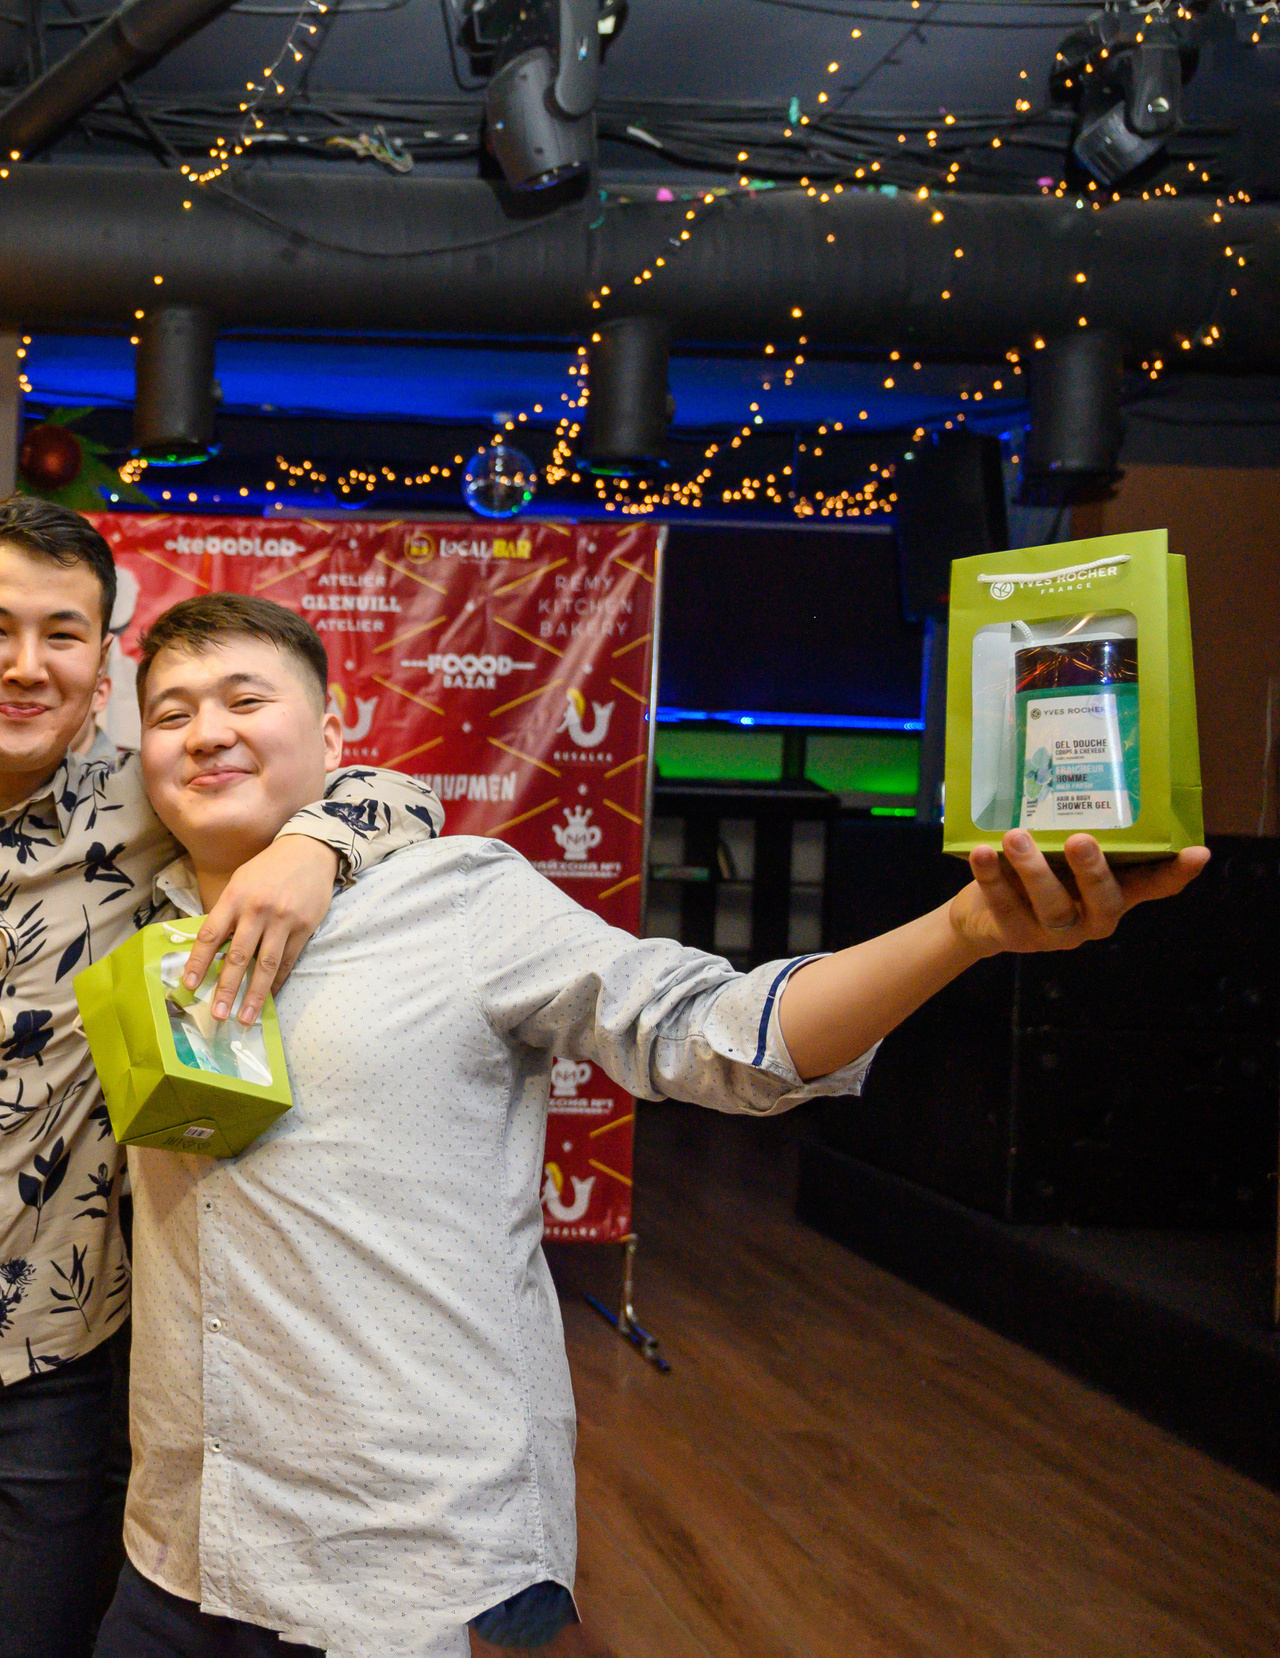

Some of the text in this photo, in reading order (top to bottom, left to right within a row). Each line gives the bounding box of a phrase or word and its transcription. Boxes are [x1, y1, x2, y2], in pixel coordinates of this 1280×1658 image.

[440, 538, 491, 559] LOCAL
[493, 539, 531, 559] BAR
[317, 573, 386, 588] ATELIER
[1056, 567, 1118, 583] ROCHER
[1040, 582, 1092, 595] FRANCE
[538, 599, 633, 615] KITCHEN
[316, 619, 385, 633] ATELIER
[540, 620, 627, 638] BAKERY
[443, 675, 496, 689] BAZAR
[1043, 708, 1065, 716] YVES
[1055, 739, 1107, 750] GEL DOUCHE
[1079, 747, 1106, 755] CHEVEUX
[1056, 773, 1088, 783] HOMME
[1056, 801, 1112, 810] SHOWER GEL
